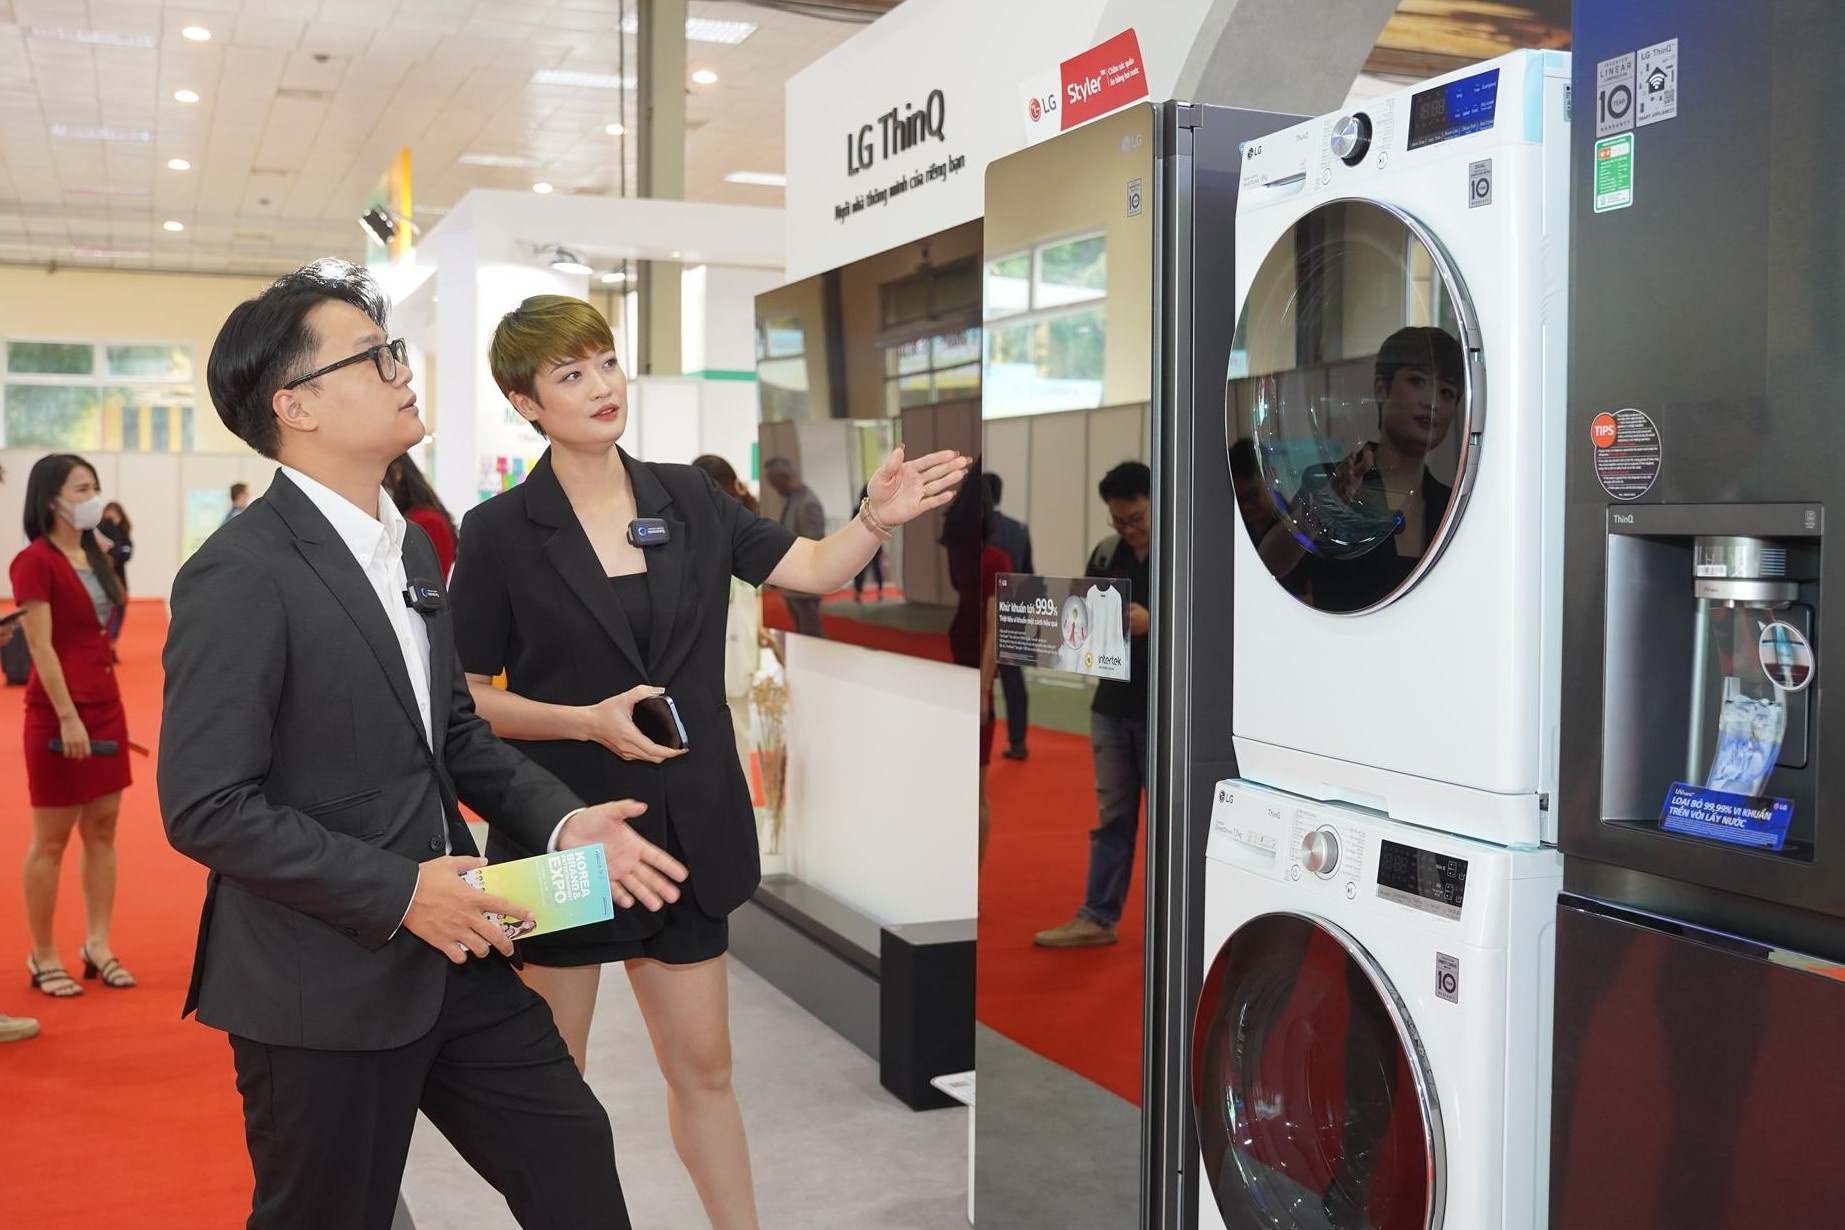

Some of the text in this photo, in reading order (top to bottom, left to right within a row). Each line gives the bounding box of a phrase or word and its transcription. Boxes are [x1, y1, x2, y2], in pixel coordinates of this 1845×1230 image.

[1641, 52, 1651, 60] LG
[1600, 62, 1632, 78] LINEAR
[1042, 94, 1056, 114] LG
[1599, 84, 1632, 124] 10
[1613, 98, 1626, 106] YEAR
[847, 89, 946, 177] LG ThinQ
[1132, 134, 1143, 150] LG
[1254, 145, 1262, 157] LG
[889, 175, 908, 198] minh
[909, 169, 924, 190] của
[926, 163, 947, 183] riêng
[948, 154, 966, 176] bạn
[1470, 177, 1490, 200] 10
[1129, 193, 1140, 211] 10
[1594, 425, 1614, 436] TIPS
[1613, 514, 1634, 524] ThinQ
[999, 600, 1011, 612] Khử
[1011, 601, 1027, 614] khuẩn
[1026, 602, 1036, 614] tới
[1098, 654, 1122, 666] intertek
[1226, 794, 1234, 804] LG
[1267, 808, 1281, 820] ThinQ
[1668, 806, 1747, 828] TRÊN VÒI LẤY NƯỚC
[1671, 796, 1772, 821] LOẠI BỎ 99,99% VI KHUẨN
[548, 856, 567, 904] EXPO
[566, 854, 580, 900] BRAND &
[574, 851, 592, 898] KOREA
[1438, 970, 1456, 995] 10
